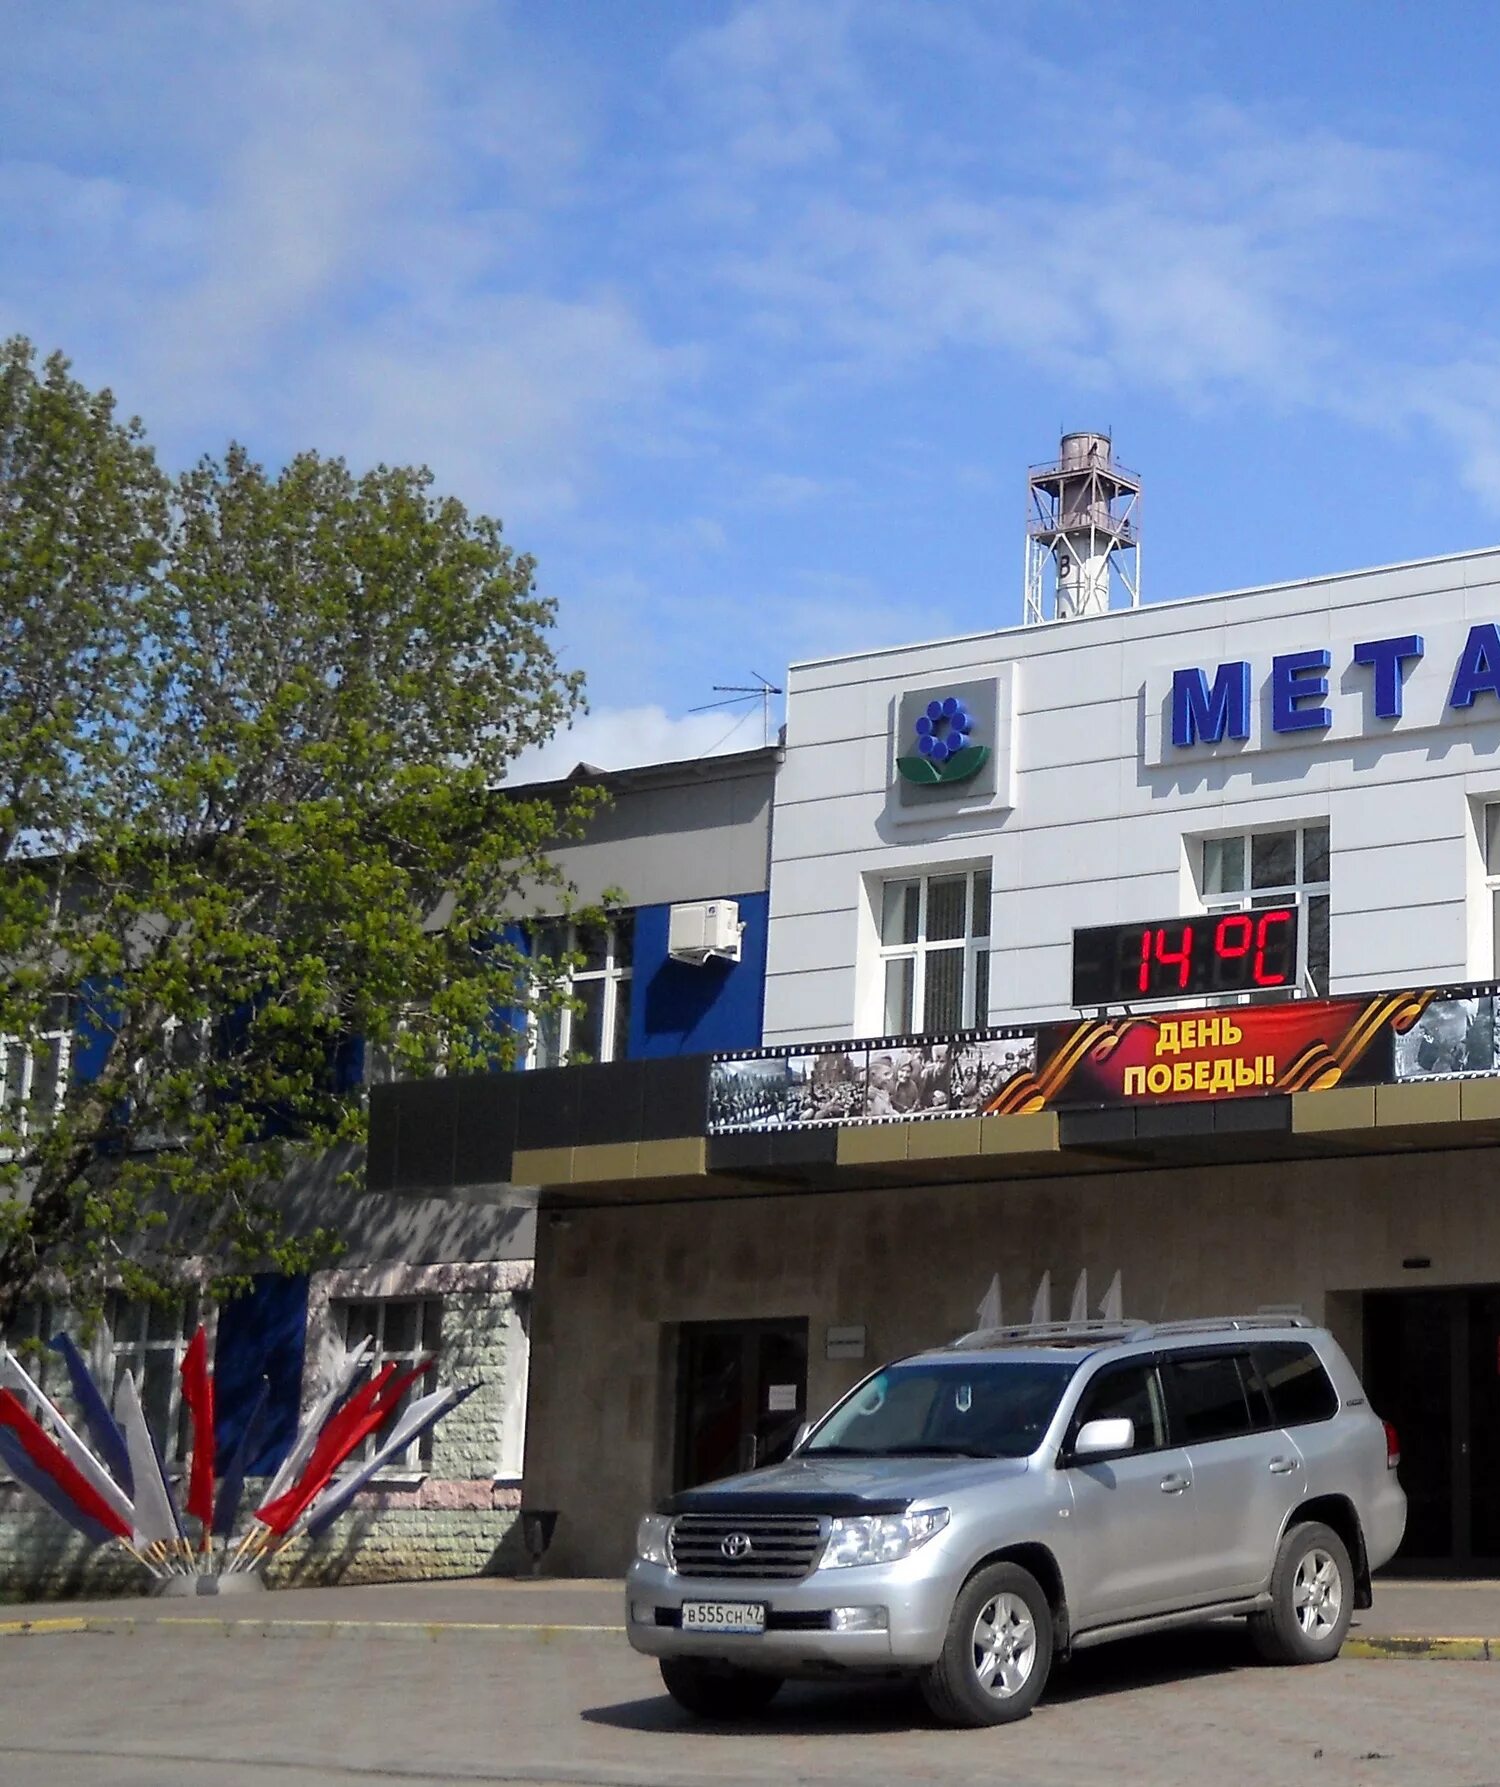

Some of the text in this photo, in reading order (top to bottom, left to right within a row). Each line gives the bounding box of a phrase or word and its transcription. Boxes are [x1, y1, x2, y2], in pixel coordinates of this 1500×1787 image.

[1138, 926, 1193, 993] 14
[1155, 1017, 1243, 1056] ДЕНЬ
[1123, 1055, 1276, 1096] ПОБЕДЫ!
